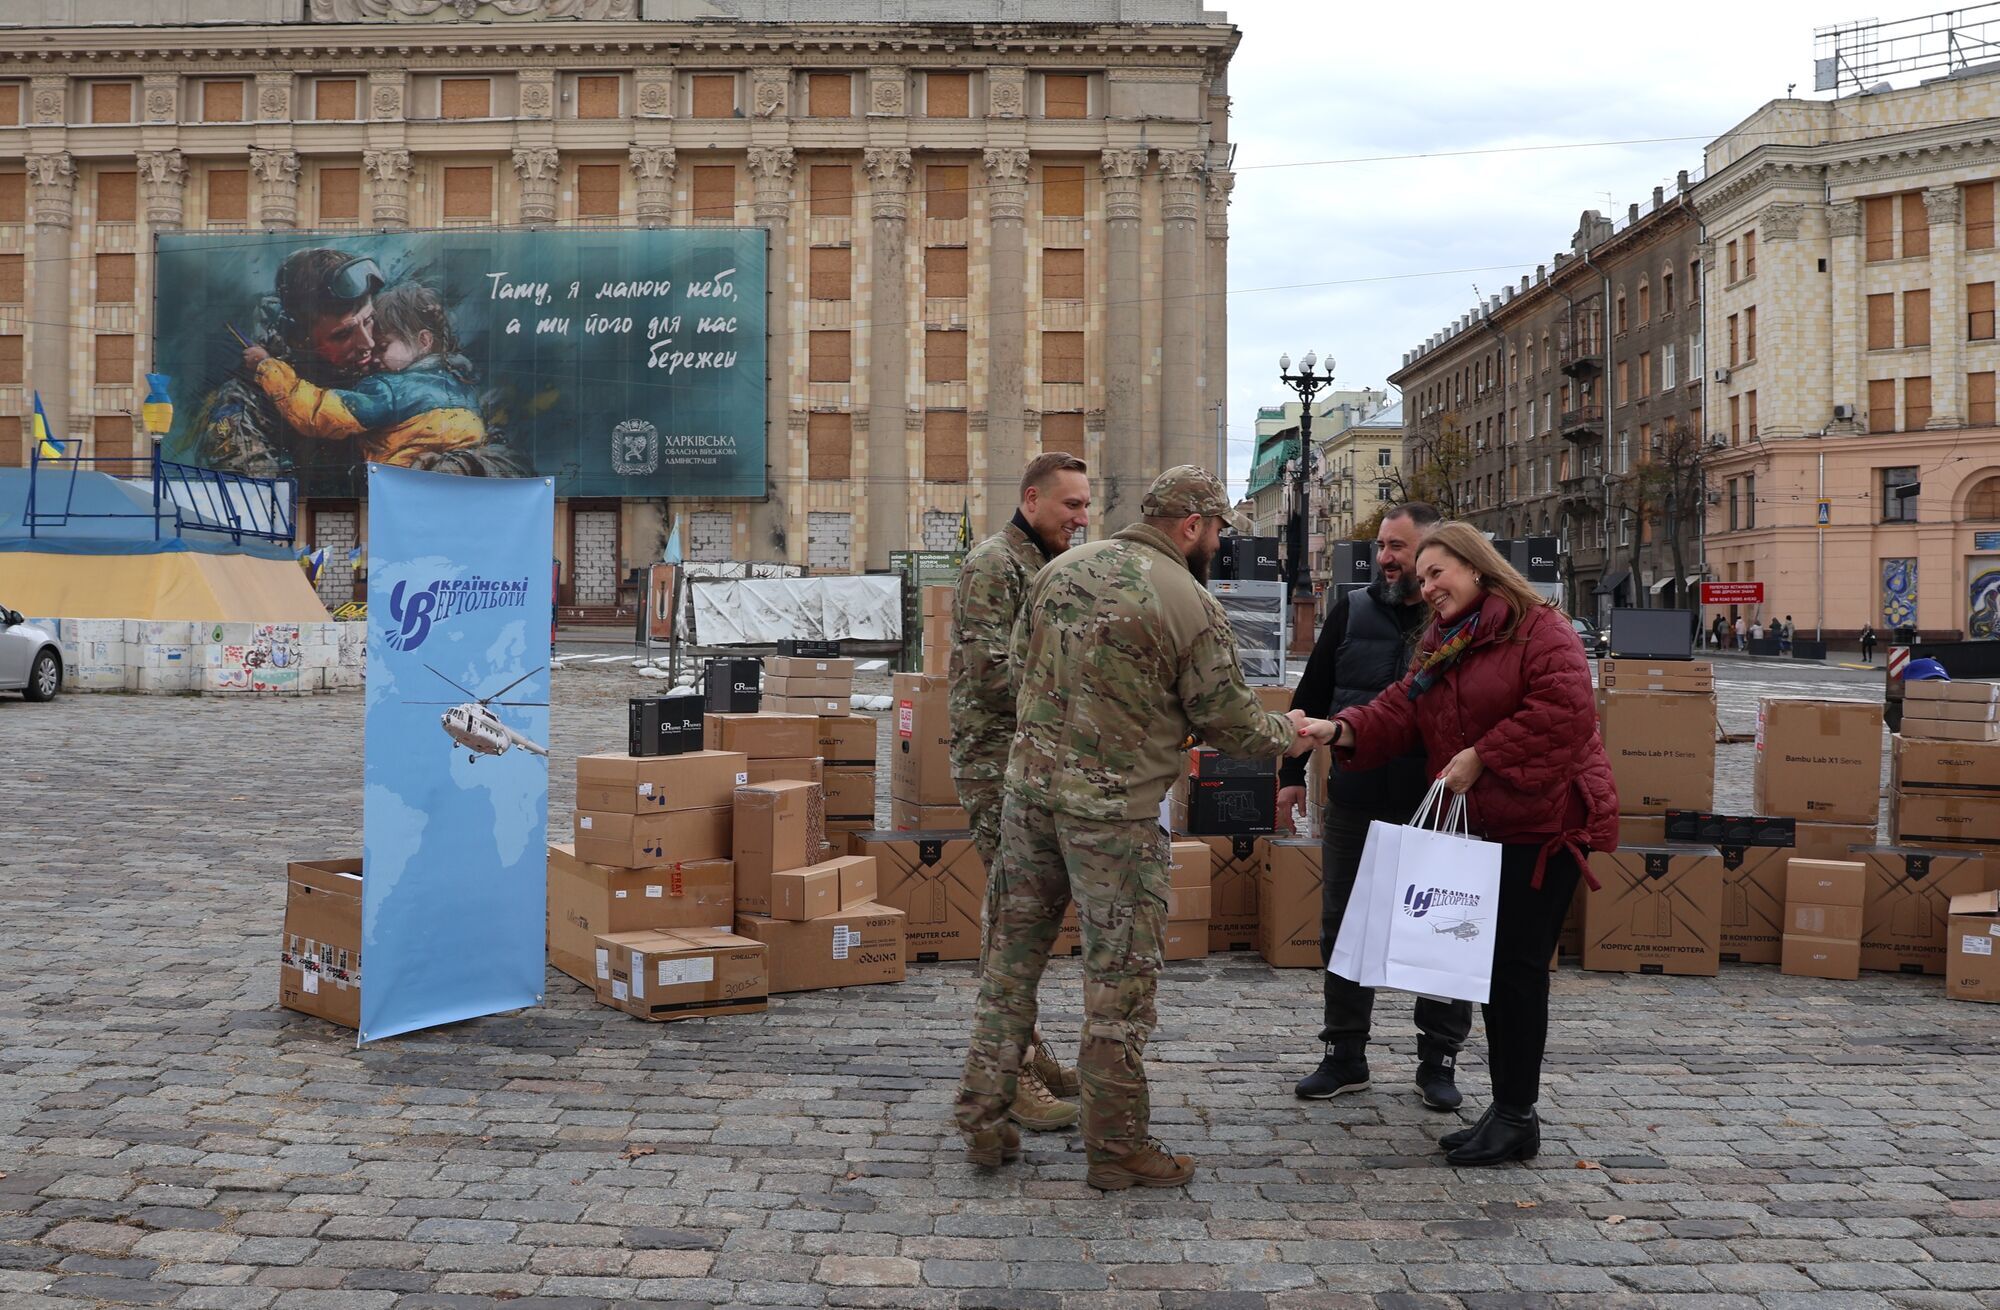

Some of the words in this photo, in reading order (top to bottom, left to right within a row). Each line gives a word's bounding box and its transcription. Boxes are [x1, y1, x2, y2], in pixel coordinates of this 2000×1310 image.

[486, 271, 552, 305] Тату,
[567, 281, 580, 299] я
[595, 280, 670, 300] малюю
[686, 268, 737, 302] небо,
[505, 317, 521, 334] а
[536, 317, 570, 336] ти
[584, 313, 633, 336] його
[647, 315, 682, 339] для
[696, 315, 737, 334] нас
[665, 435, 736, 447] ХАРКІВСЬКА
[1622, 749, 1647, 757] Bambu
[1785, 755, 1811, 763] Bambu
[1813, 756, 1826, 764] Lab
[905, 932, 940, 940] OMPUTER
[1601, 943, 1633, 951] КОРПУС
[1634, 944, 1651, 953] ДЛЯ
